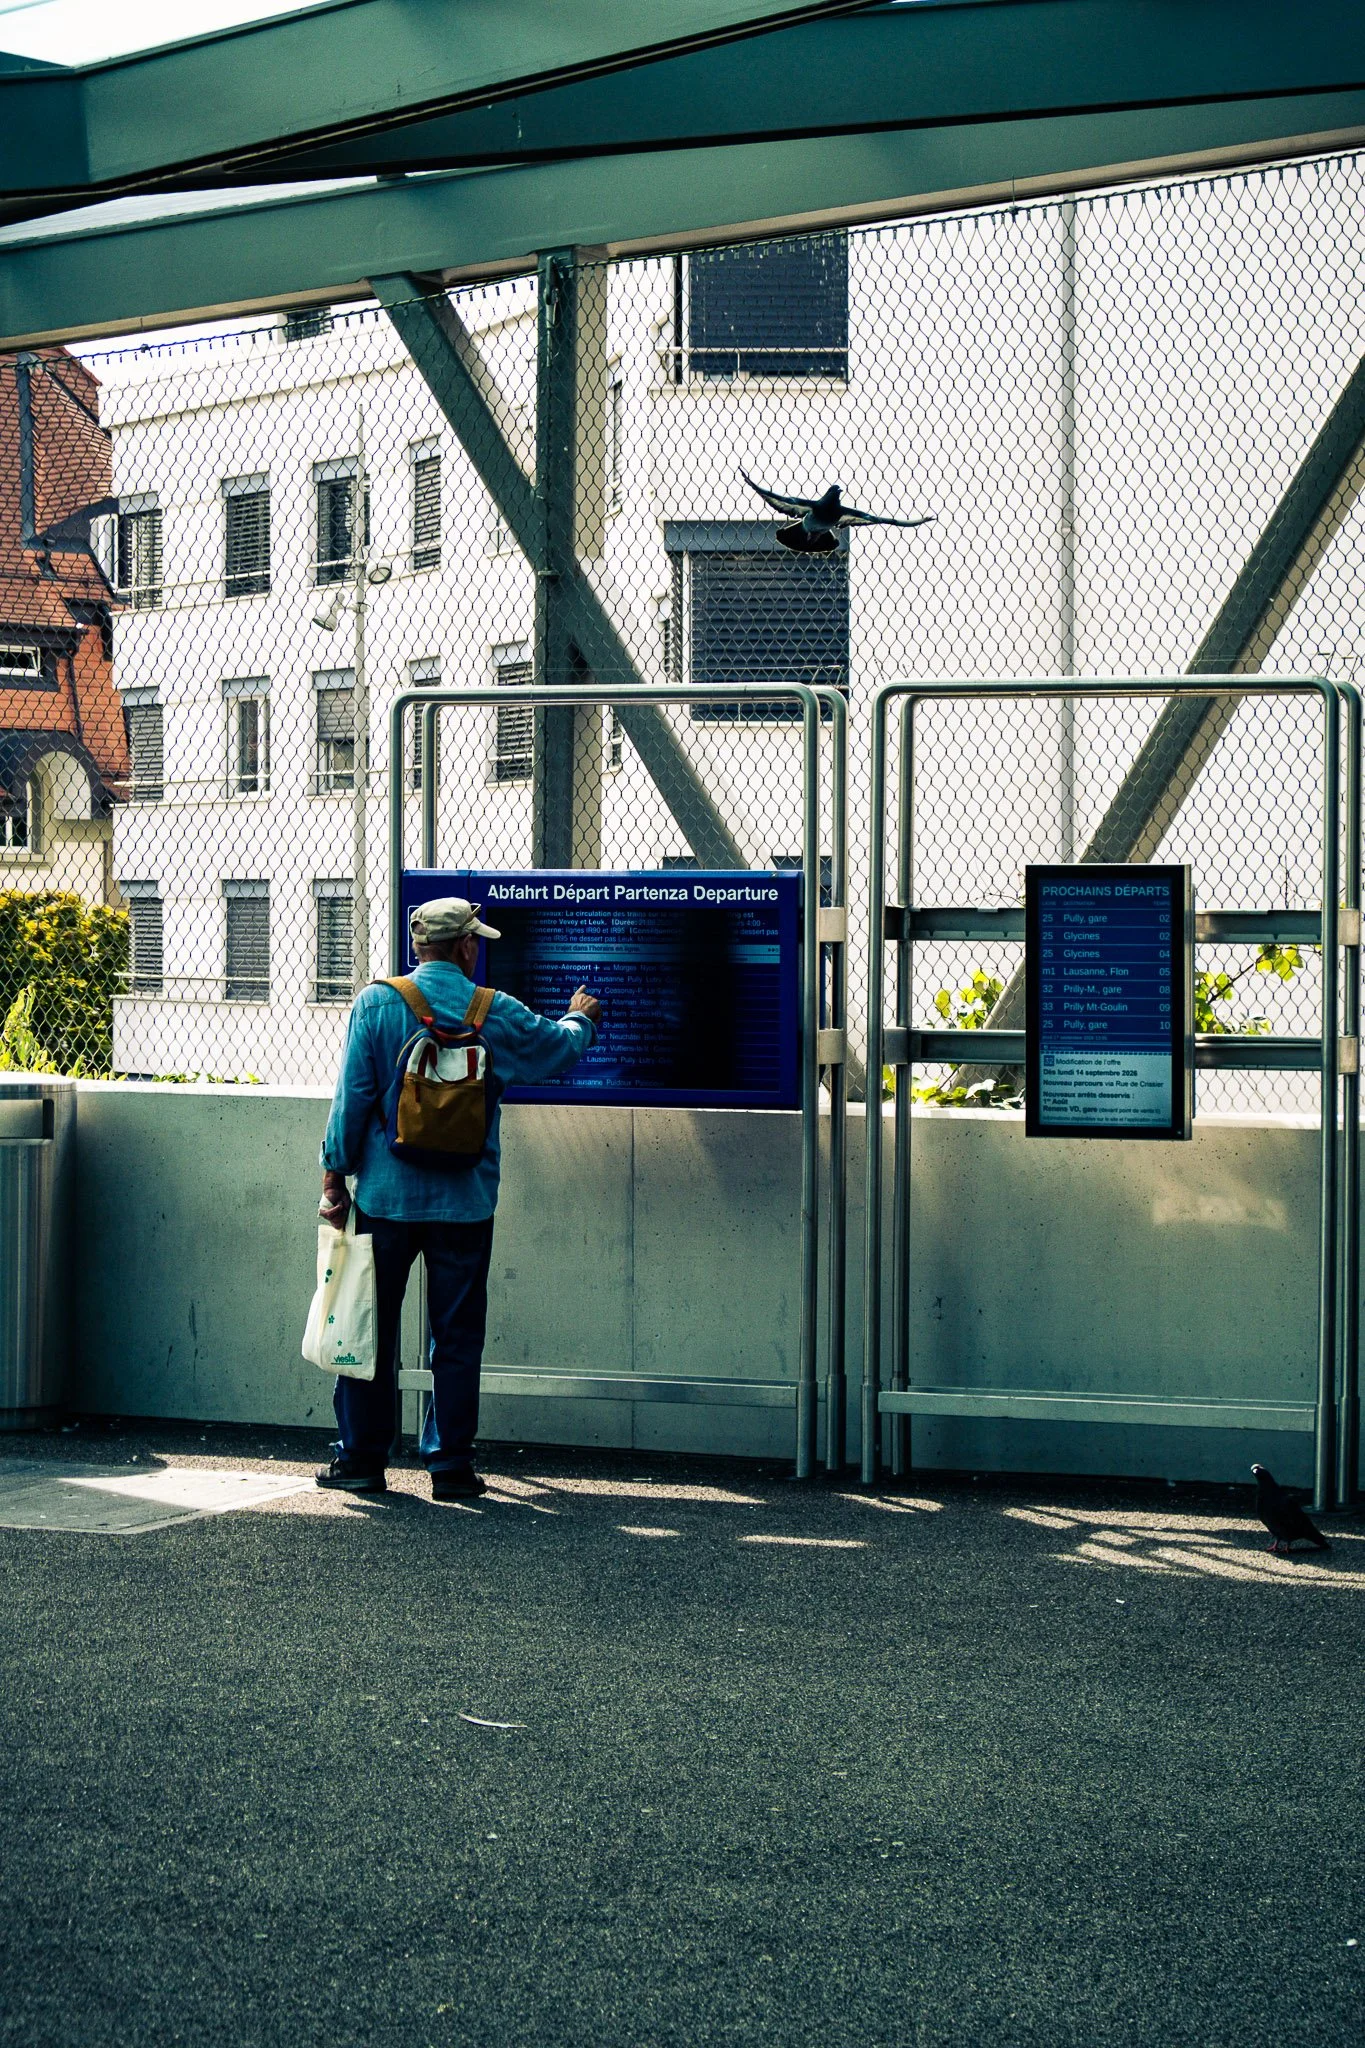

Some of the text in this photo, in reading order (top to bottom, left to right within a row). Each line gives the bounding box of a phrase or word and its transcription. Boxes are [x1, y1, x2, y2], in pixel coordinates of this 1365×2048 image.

[488, 883, 778, 903] Abfahrt Départ Partenza Departure
[1042, 884, 1170, 896] PROCHAINS DÉPARTS
[1042, 914, 1170, 924] 25 Pully, gare 02
[1042, 931, 1170, 942] 25 Glycines 02
[1042, 949, 1170, 959] 25 Glycines 04
[1063, 967, 1107, 976] Lausanne,
[1110, 967, 1129, 976] Flon
[1159, 968, 1170, 976] 05
[1042, 985, 1053, 993] 32
[1102, 986, 1122, 996] gare
[1159, 985, 1170, 994] 08
[1042, 1002, 1053, 1011] 33
[1063, 1002, 1085, 1012] Prilly
[1159, 1003, 1170, 1012] 09
[1042, 1020, 1170, 1031] 25 Pully, gare 10
[1085, 1069, 1120, 1077] septembre
